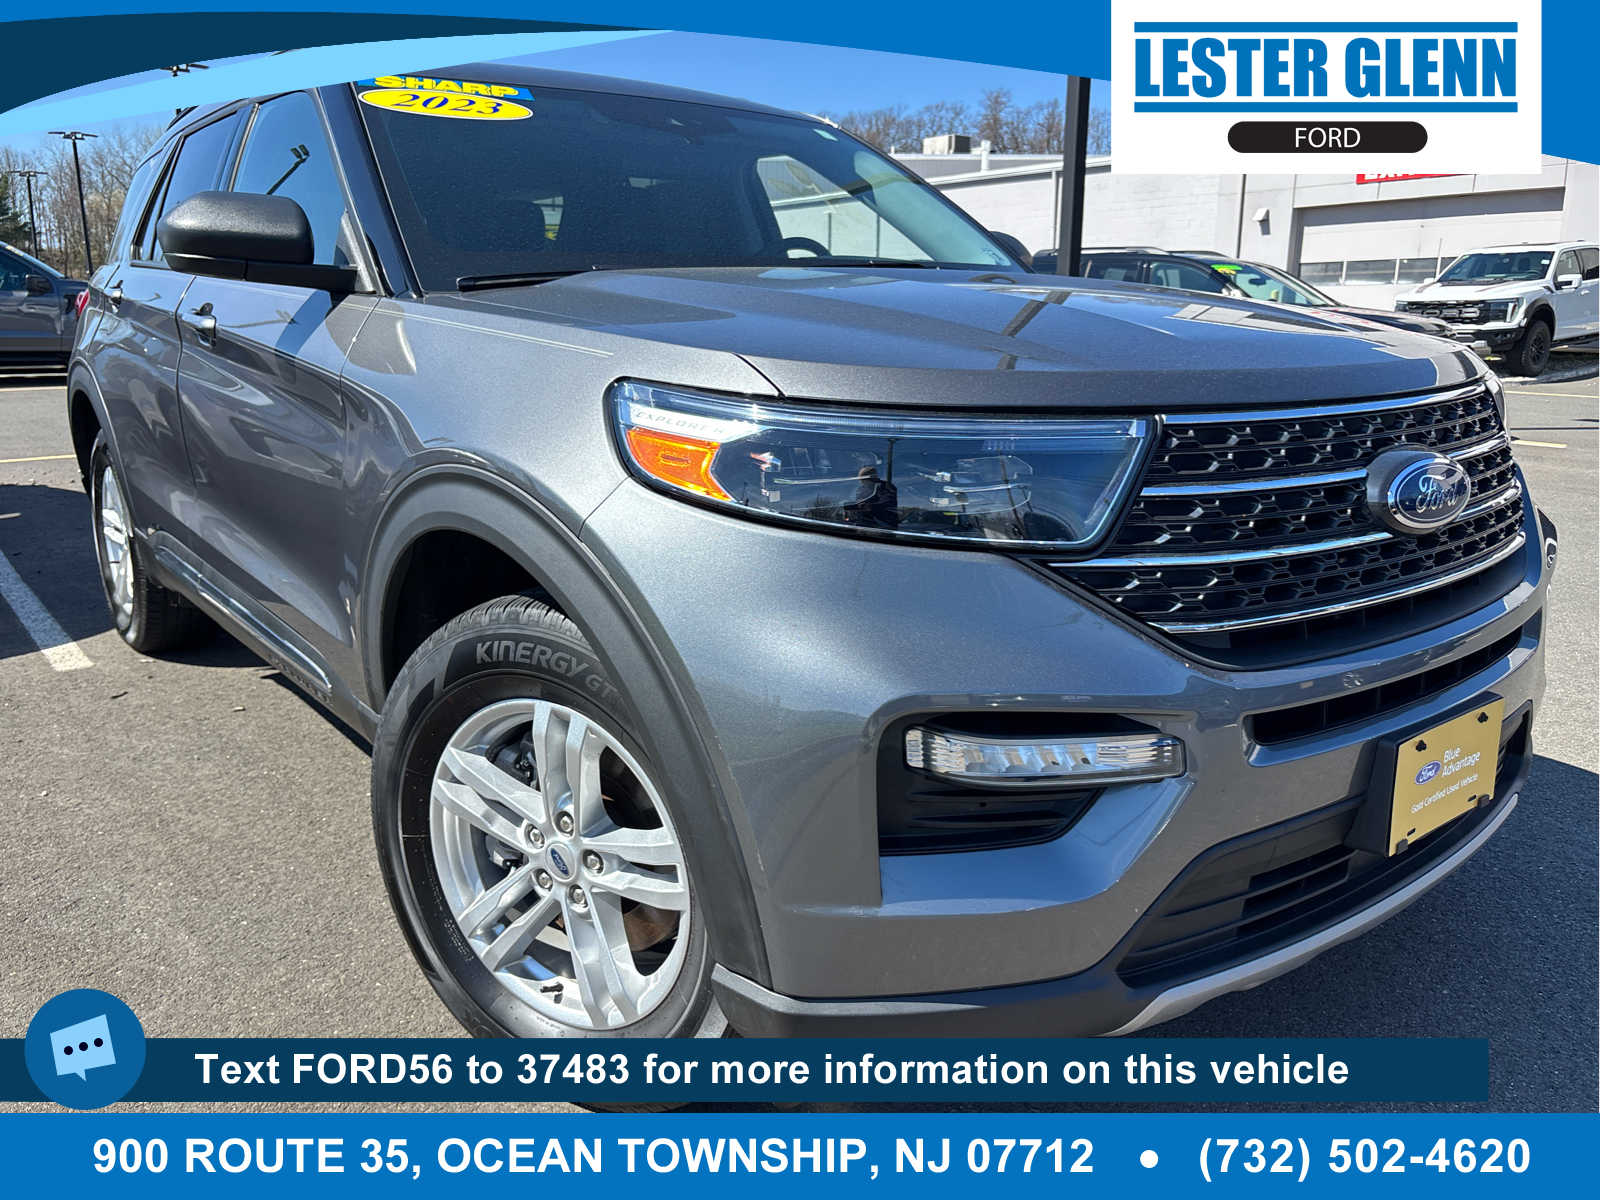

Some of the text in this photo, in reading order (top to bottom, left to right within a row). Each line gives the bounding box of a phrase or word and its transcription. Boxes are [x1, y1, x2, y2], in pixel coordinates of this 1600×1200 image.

[374, 75, 519, 98] SHARP
[392, 93, 503, 115] 2023
[1415, 473, 1460, 513] Ford
[475, 640, 618, 700] KINERGY GT
[1418, 751, 1481, 782] Ford Advantage
[1443, 747, 1461, 763] Blue
[1411, 774, 1478, 814] Gold Certified Used Vehicle
